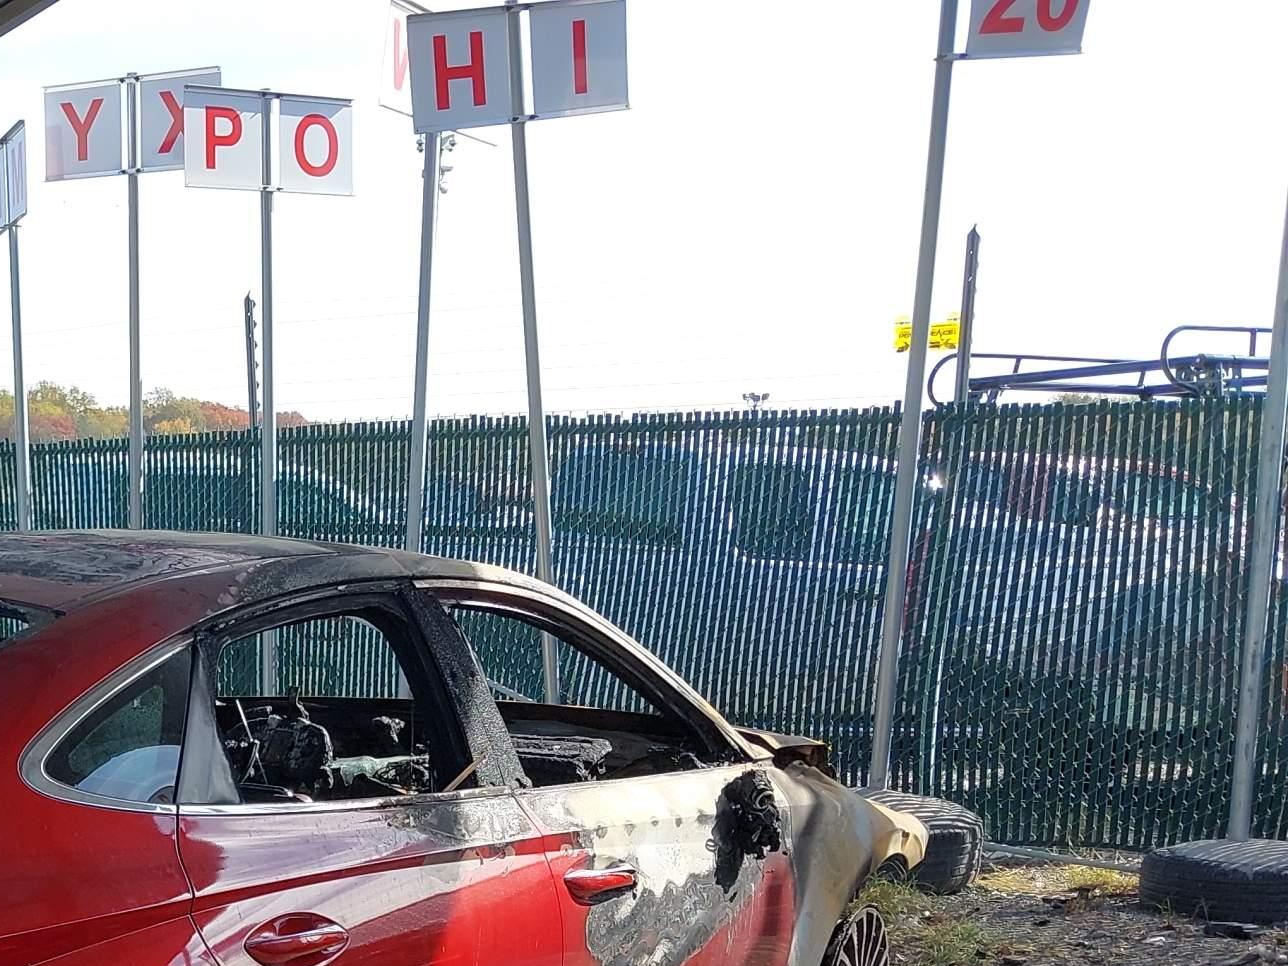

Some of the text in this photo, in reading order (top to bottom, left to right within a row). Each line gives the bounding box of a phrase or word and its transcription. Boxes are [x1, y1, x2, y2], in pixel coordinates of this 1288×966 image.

[432, 30, 487, 111] H
[572, 19, 588, 95] I
[59, 97, 105, 162] Y
[204, 105, 339, 178] P O
